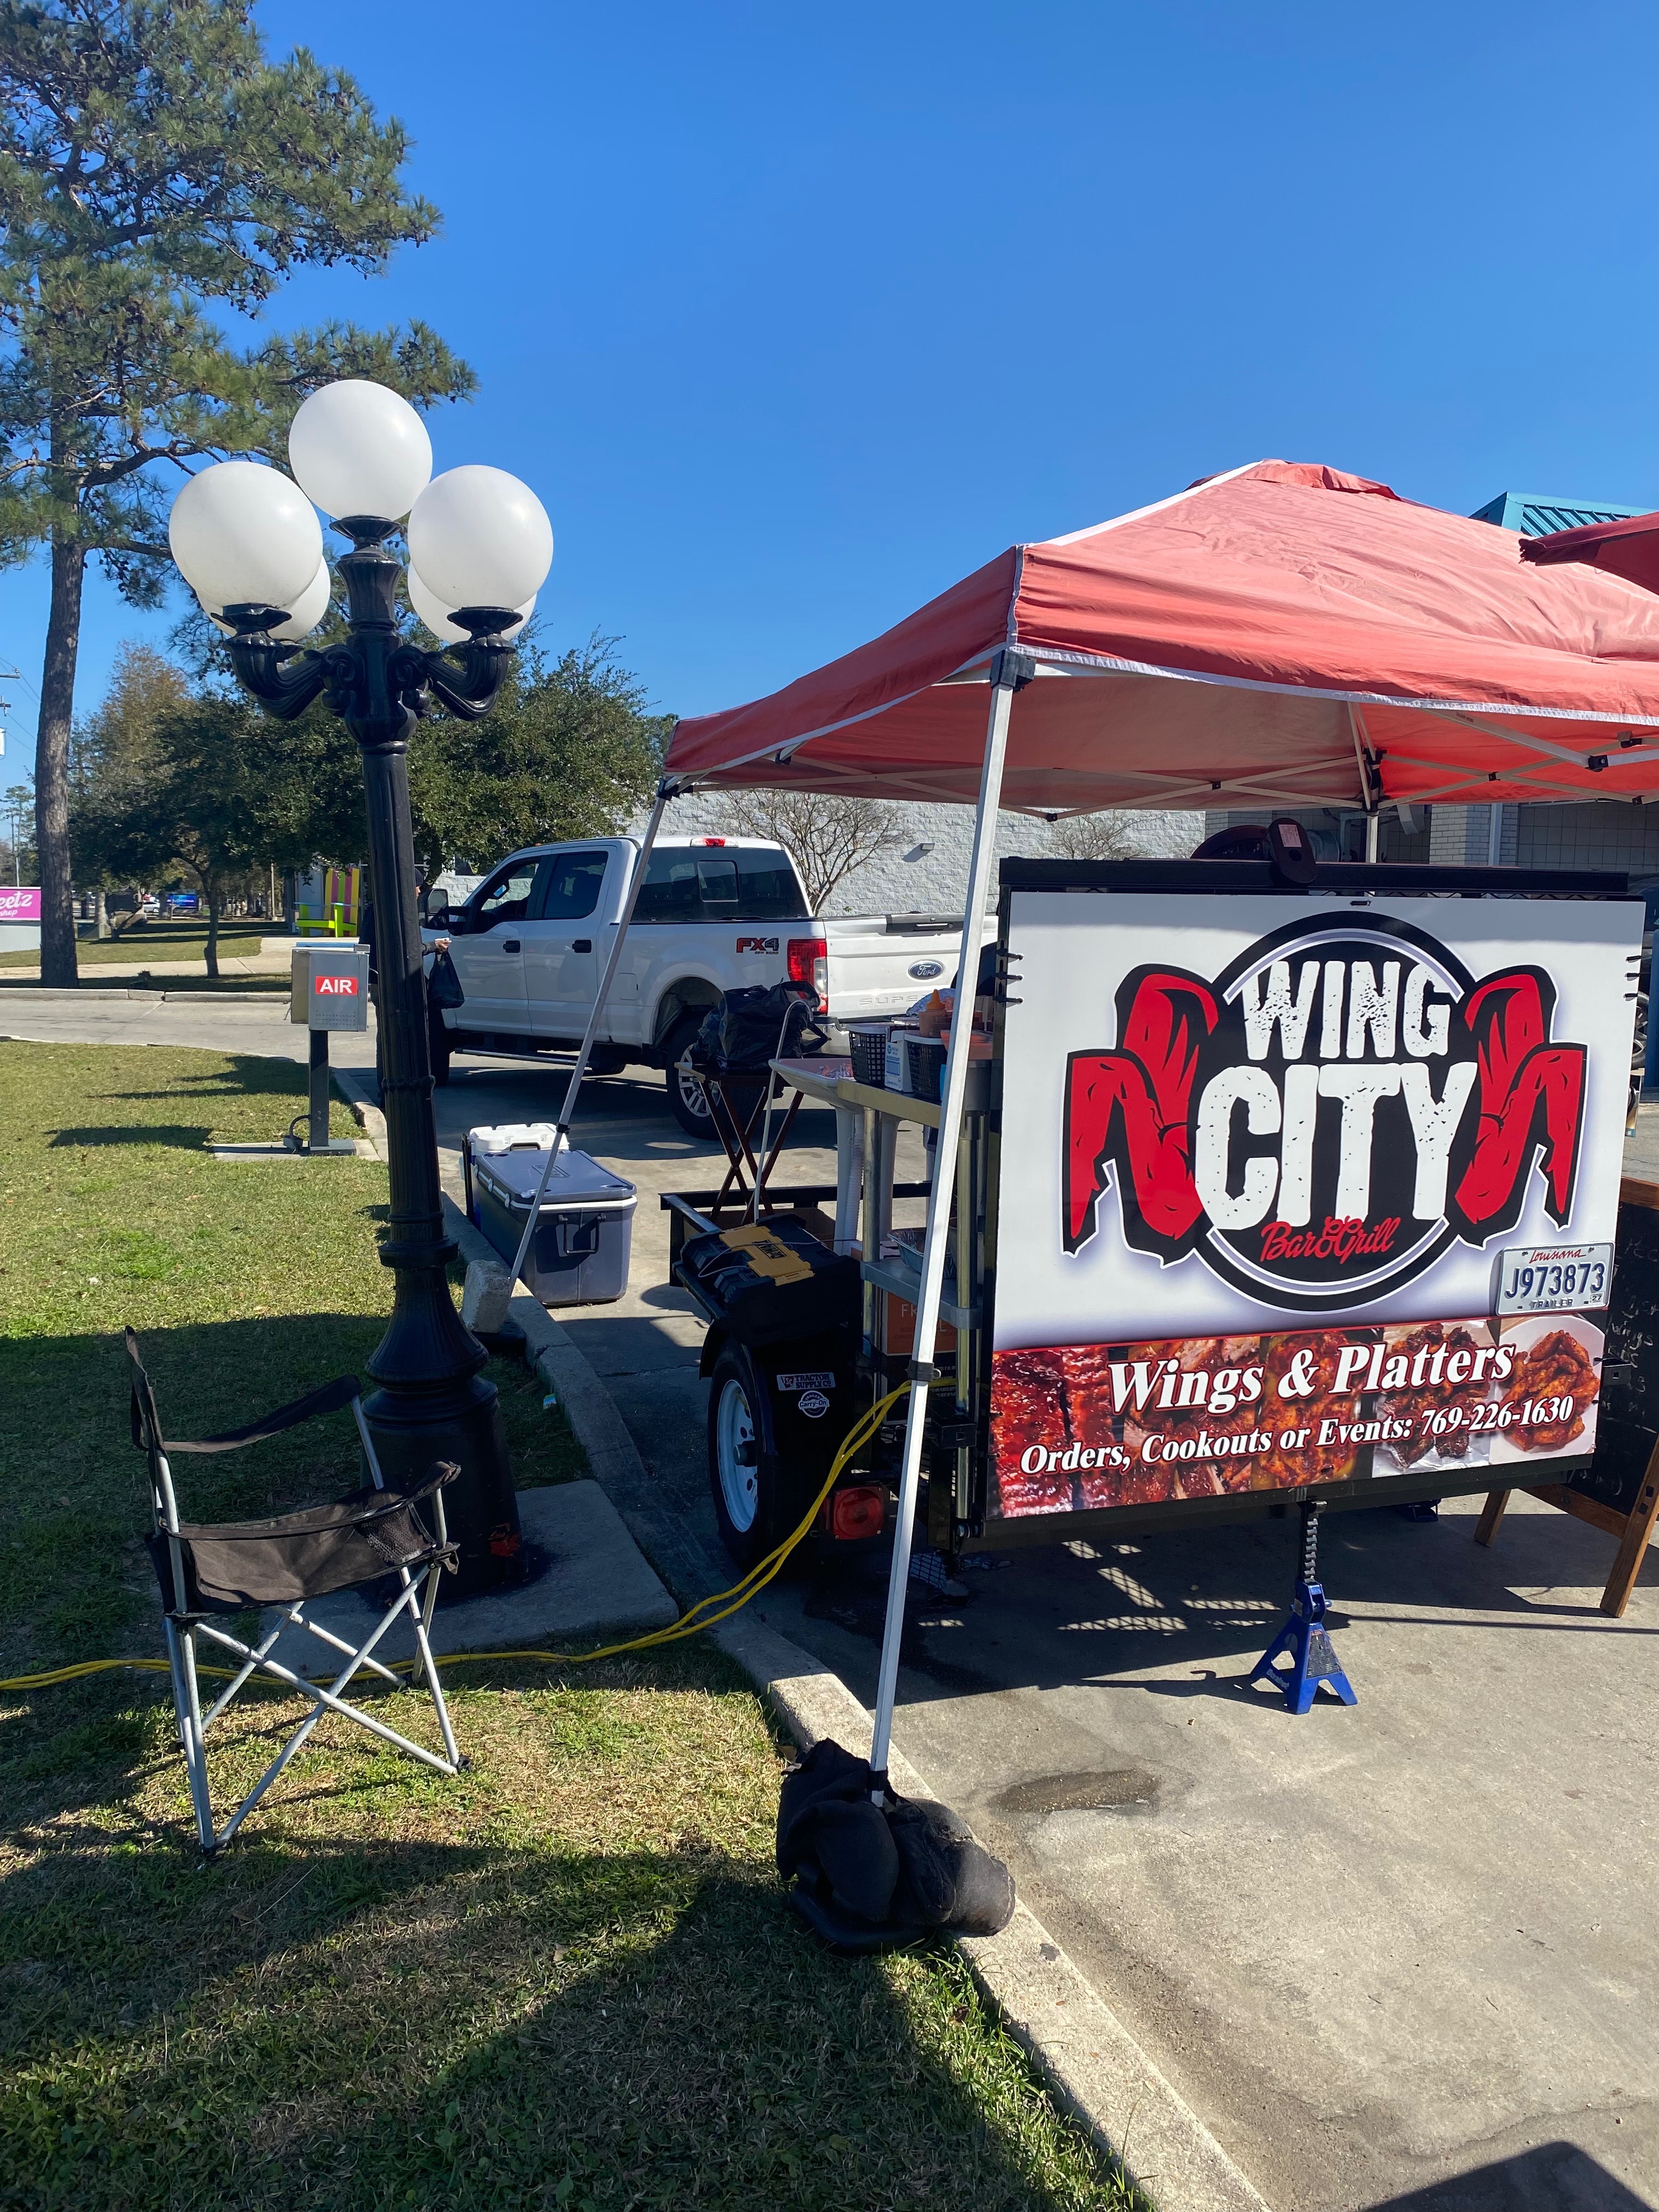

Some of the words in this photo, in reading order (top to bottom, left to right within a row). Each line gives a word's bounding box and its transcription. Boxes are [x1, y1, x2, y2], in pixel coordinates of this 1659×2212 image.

[736, 938, 779, 953] FX4
[917, 964, 936, 976] Ford
[319, 979, 353, 994] AIR
[859, 995, 925, 1006] SUPE
[1242, 961, 1451, 1060] WING
[1195, 1062, 1479, 1229] CITY
[1529, 1249, 1587, 1263] Louisiana
[1505, 1261, 1605, 1299] J973873
[1531, 1298, 1573, 1310] TRAILER
[796, 1380, 822, 1389] SUPPLY
[1108, 1359, 1263, 1414] Wings
[1277, 1348, 1319, 1398] &
[1328, 1342, 1515, 1394] Platters
[1020, 1441, 1131, 1474] Orders,
[1142, 1426, 1272, 1463] Cookouts
[1279, 1427, 1311, 1448] or
[1316, 1417, 1412, 1446] Events:
[1421, 1396, 1573, 1435] 769-226-1630
